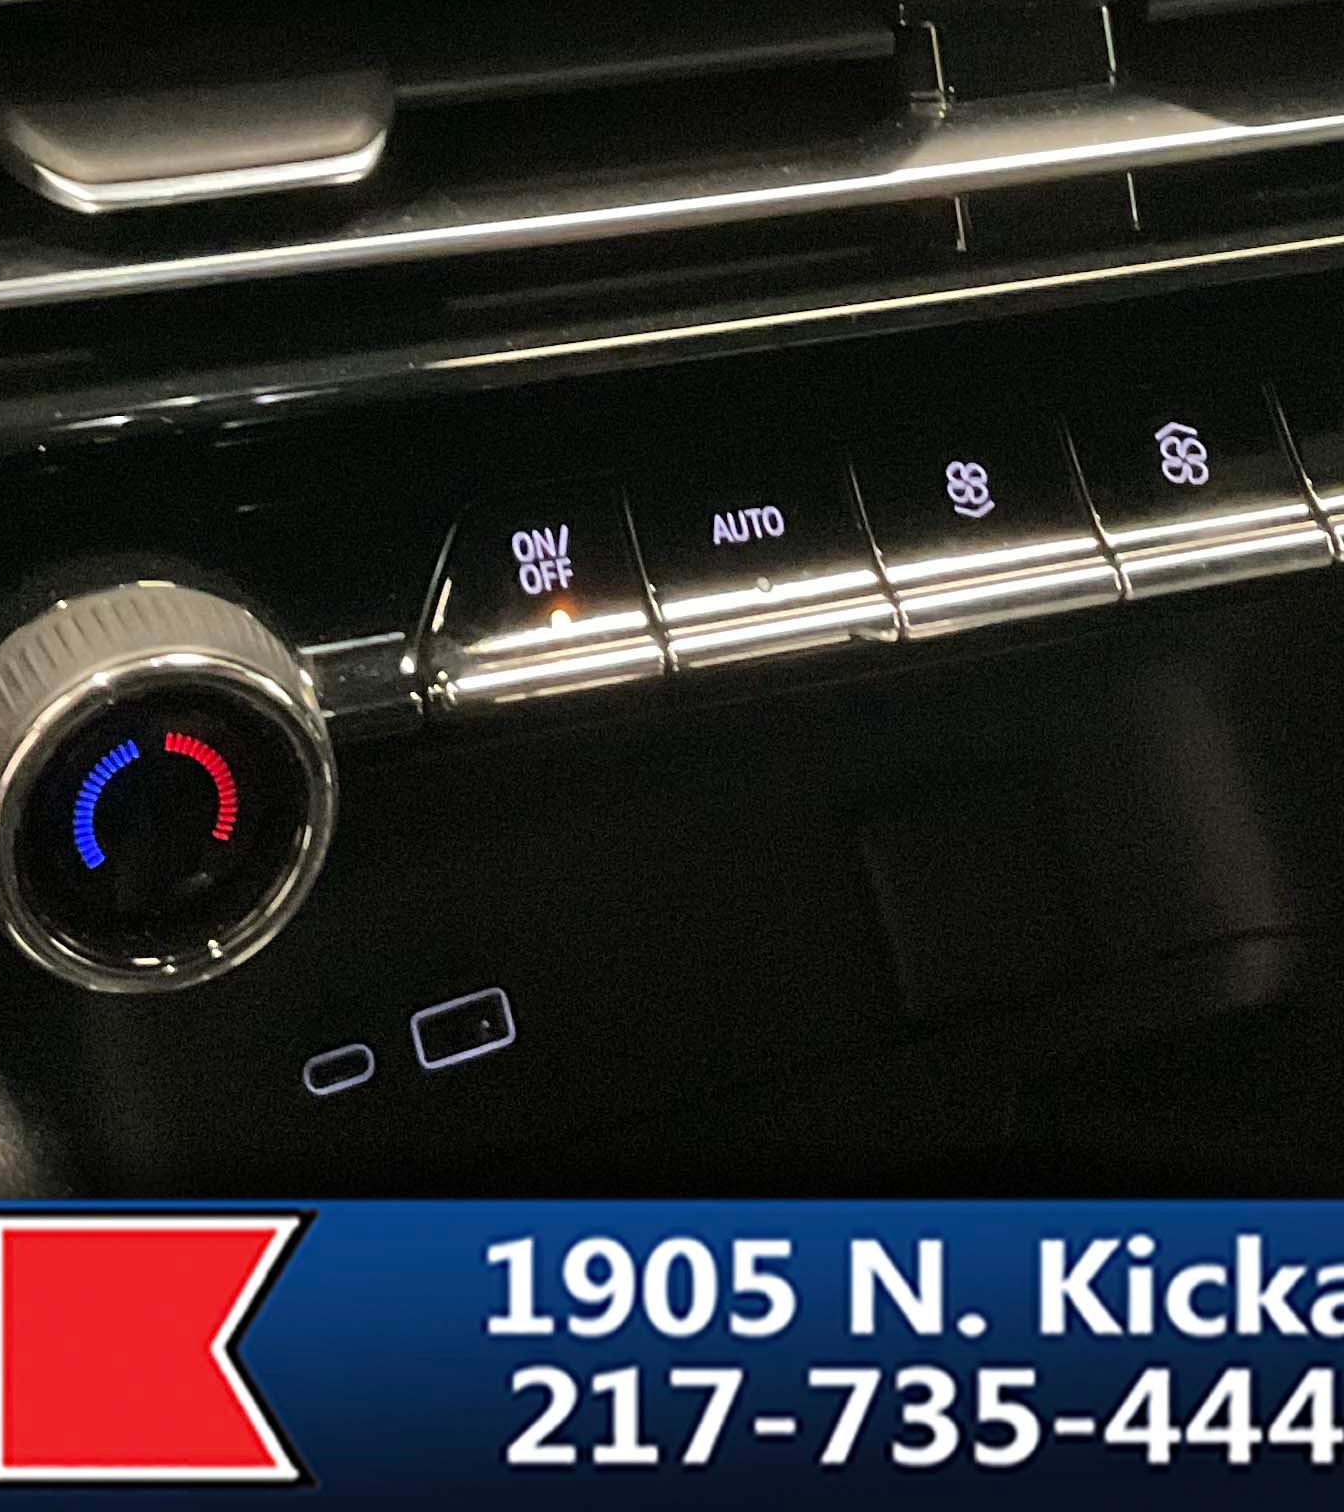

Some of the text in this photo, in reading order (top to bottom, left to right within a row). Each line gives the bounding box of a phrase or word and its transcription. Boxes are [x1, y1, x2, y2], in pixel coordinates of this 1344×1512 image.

[511, 524, 569, 563] ON/
[712, 505, 785, 545] AUTO
[518, 558, 574, 595] OFF
